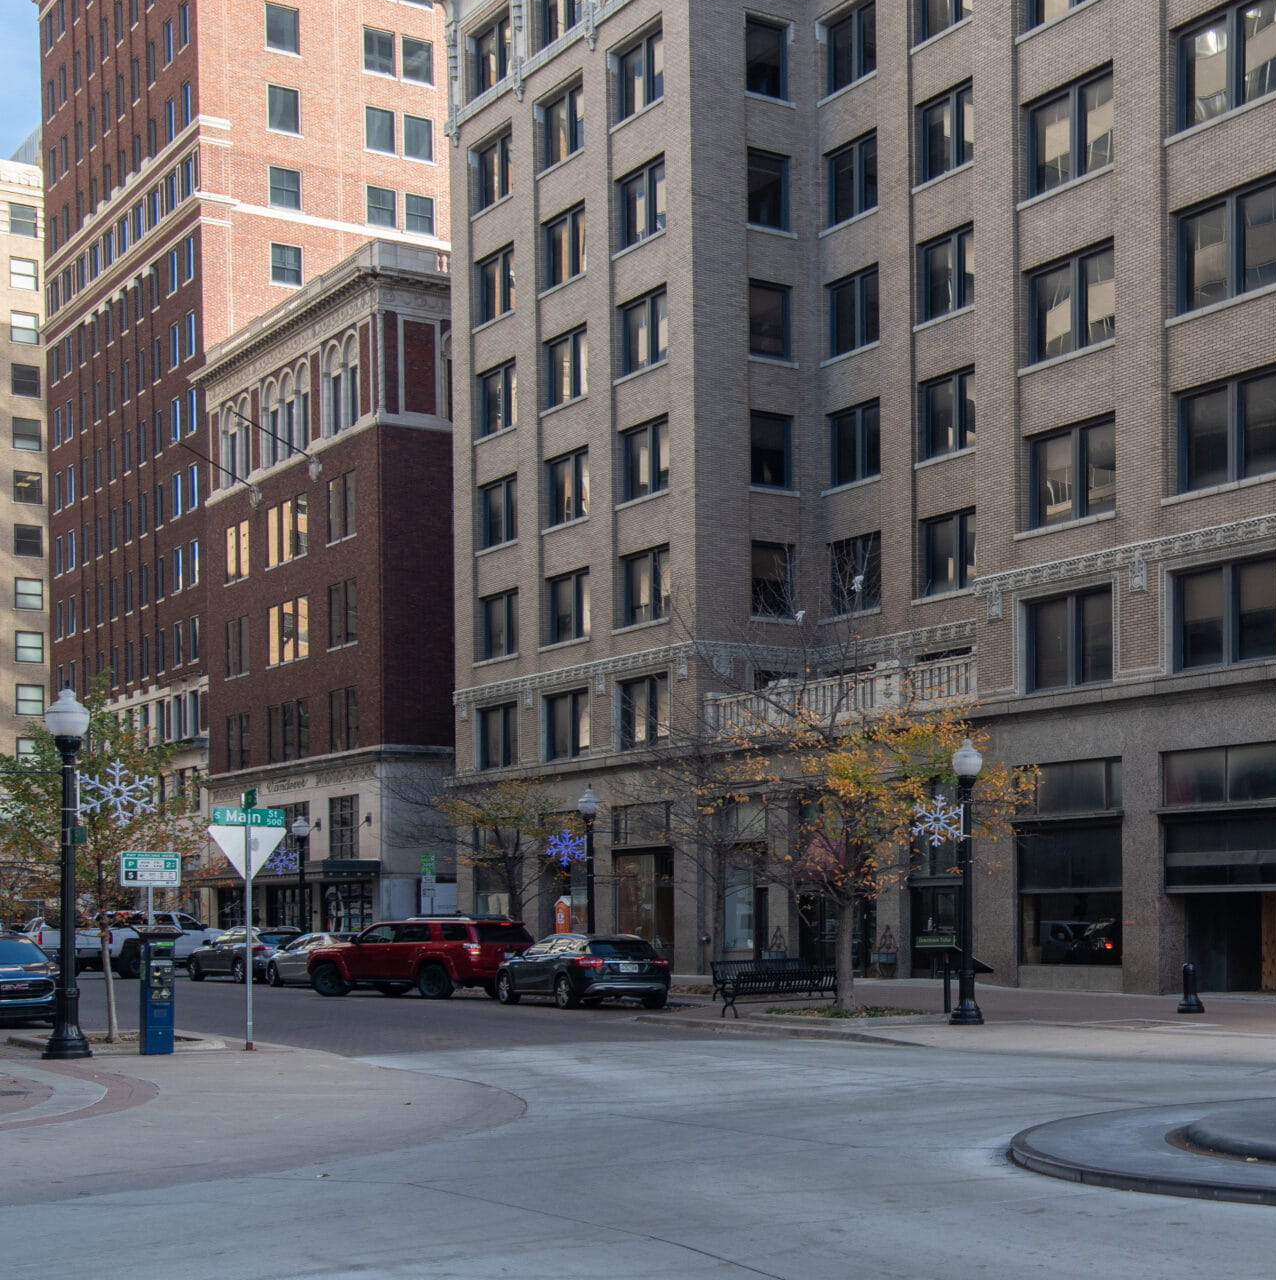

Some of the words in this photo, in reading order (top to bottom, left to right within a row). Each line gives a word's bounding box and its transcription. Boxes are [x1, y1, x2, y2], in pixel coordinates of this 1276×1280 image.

[215, 811, 221, 819] S
[226, 810, 260, 824] Main
[268, 810, 278, 818] St
[266, 818, 282, 826] 500
